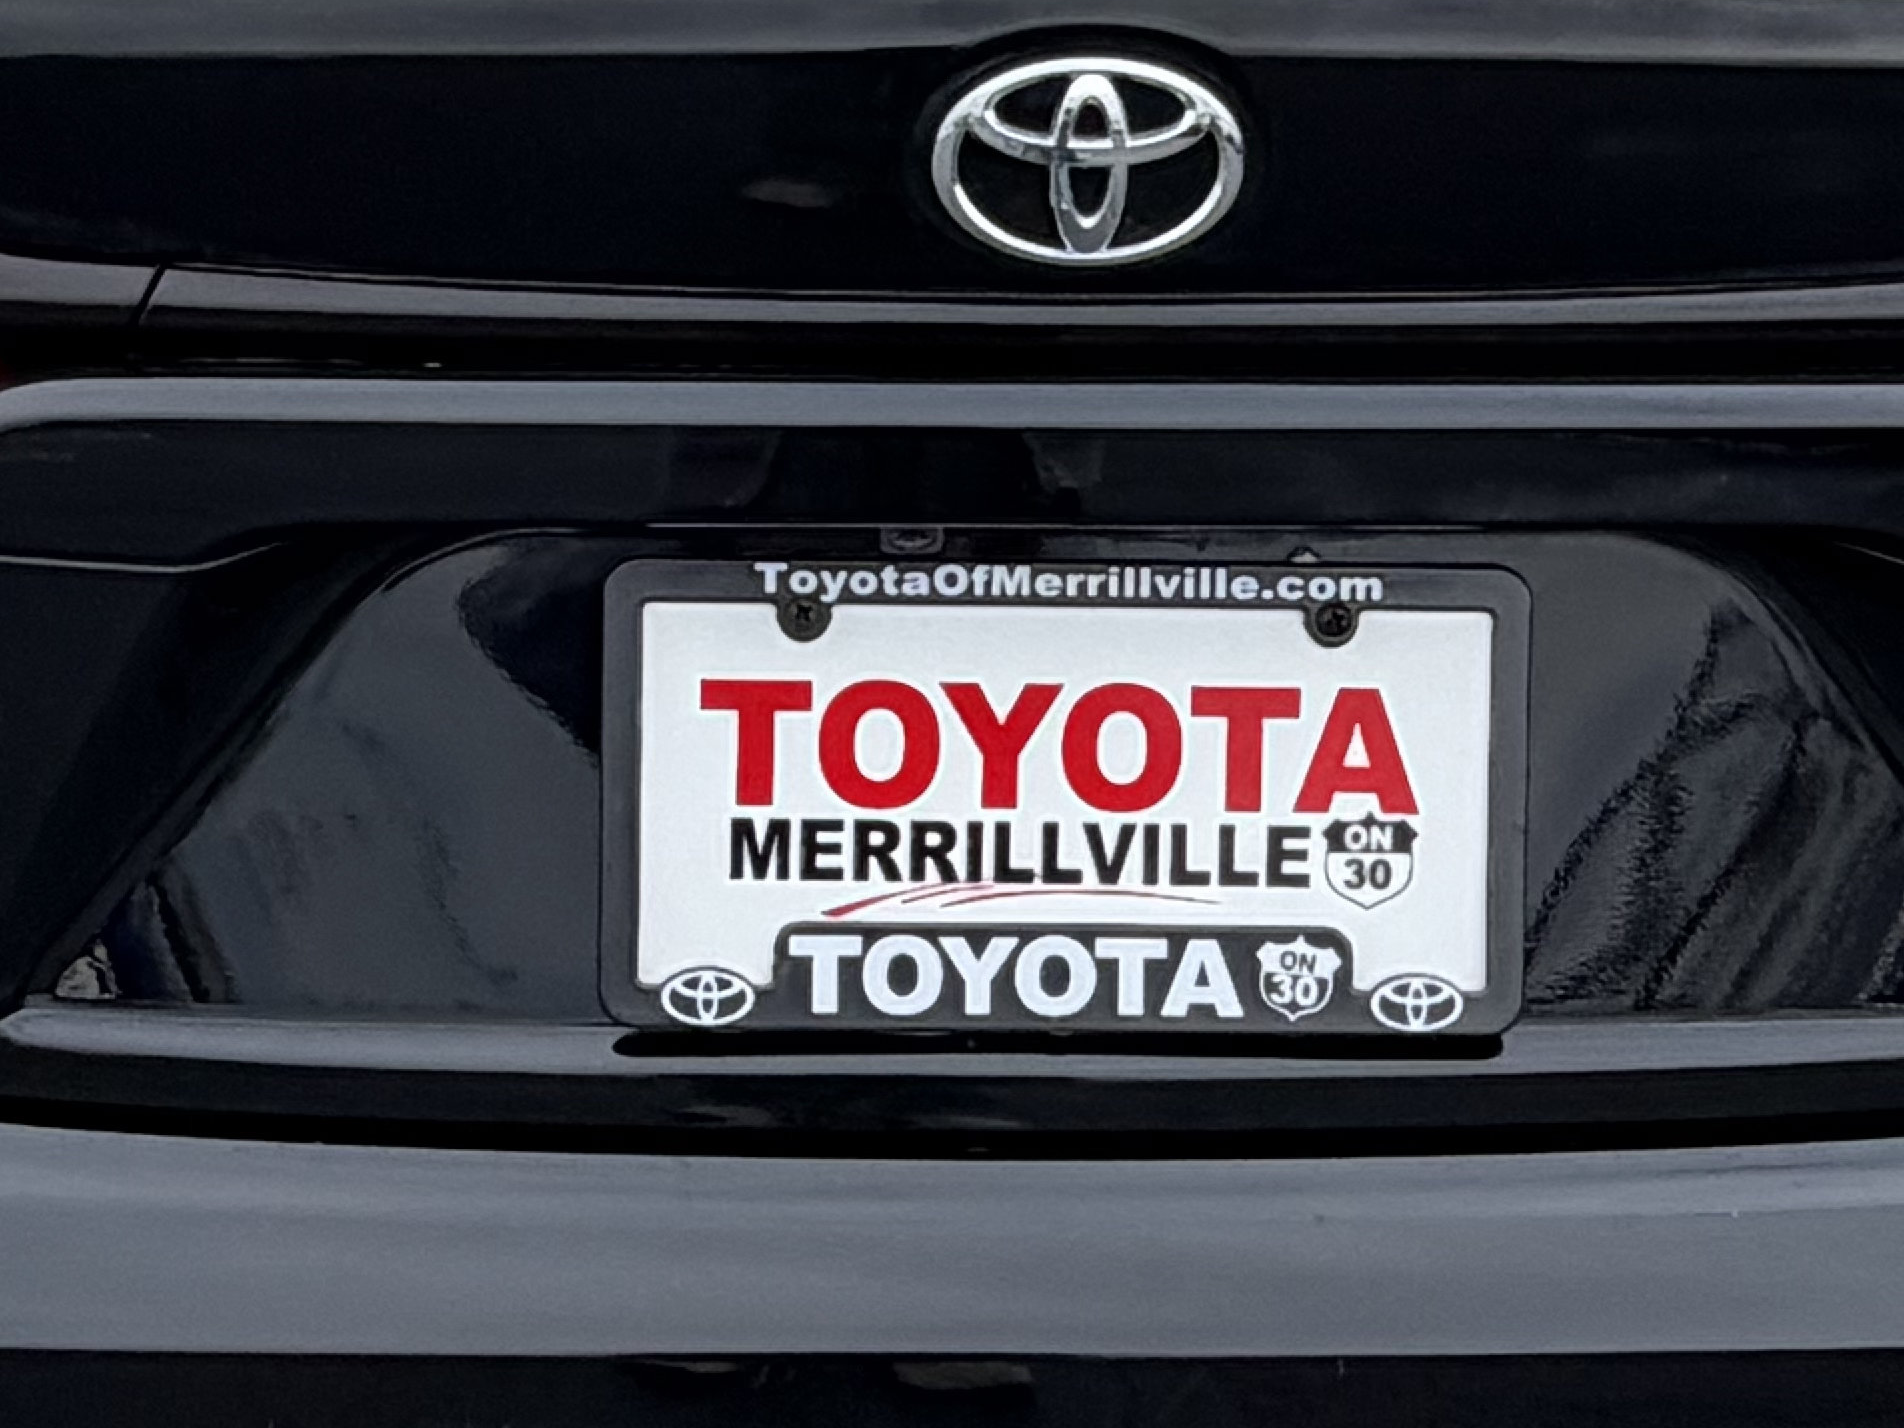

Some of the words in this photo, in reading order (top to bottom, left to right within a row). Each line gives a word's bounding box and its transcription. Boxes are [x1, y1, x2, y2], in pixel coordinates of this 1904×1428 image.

[754, 562, 1384, 603] ToyotaOfMerrillville.com
[700, 679, 1418, 815] TOYOTA
[730, 818, 1311, 888] MERRILLVILLE
[1344, 825, 1393, 850] ON
[1344, 859, 1393, 890] 30
[788, 934, 1244, 1018] TOYOTA
[1280, 950, 1317, 973] ON
[1270, 974, 1319, 1007] 30
